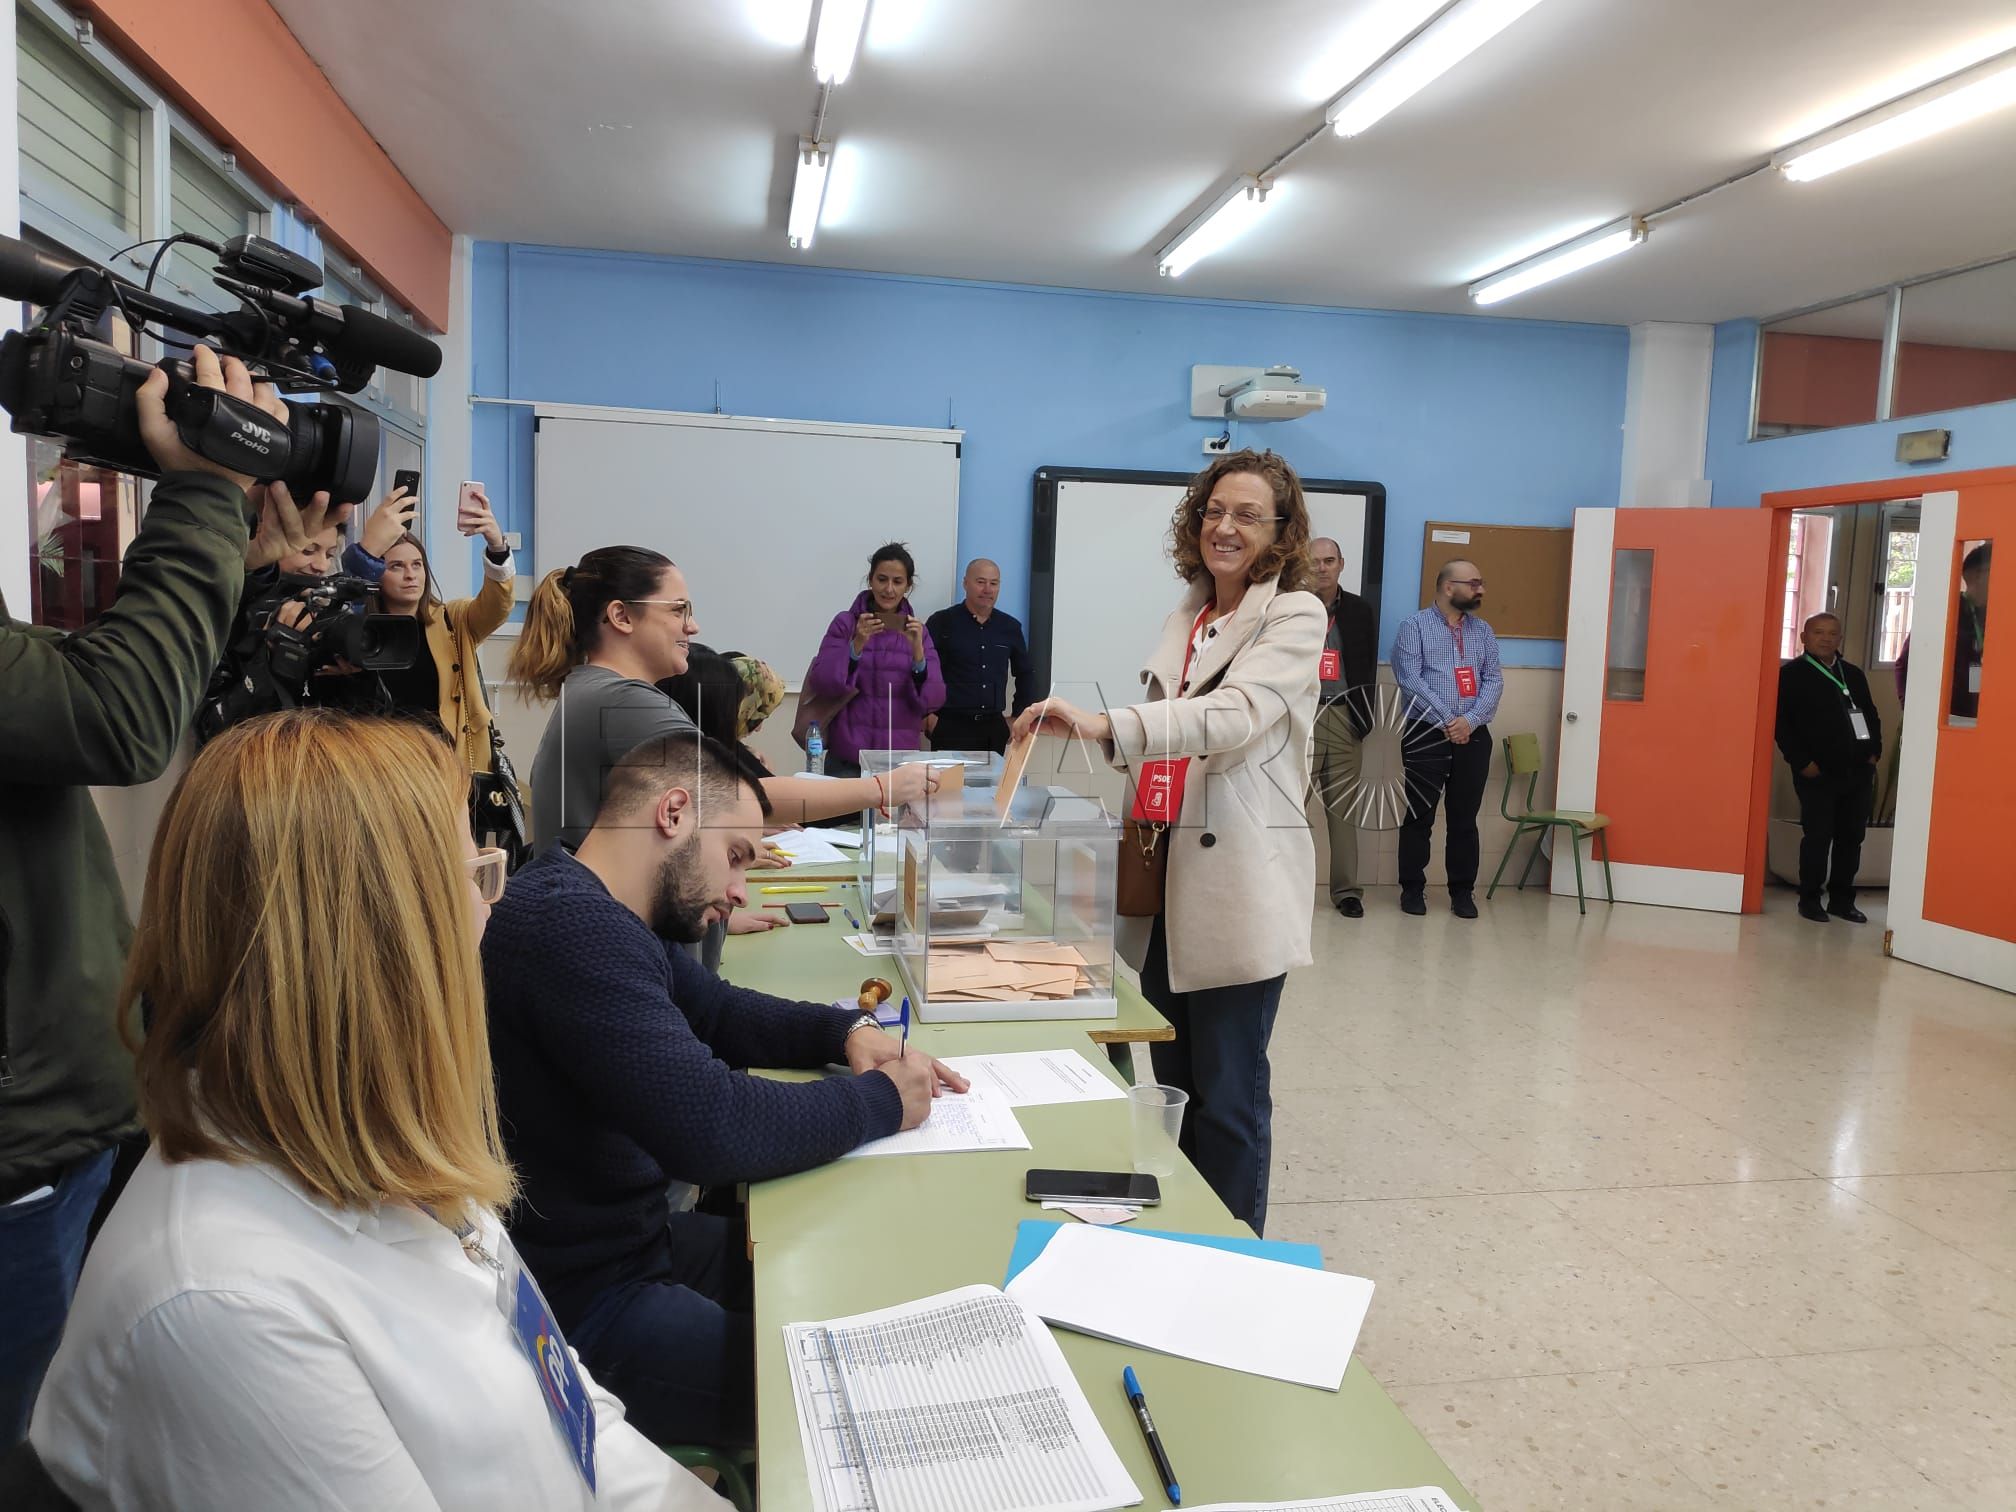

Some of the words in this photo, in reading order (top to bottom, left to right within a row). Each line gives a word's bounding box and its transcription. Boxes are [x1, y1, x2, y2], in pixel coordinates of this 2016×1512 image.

[231, 431, 270, 455] ProHD
[242, 421, 271, 443] JVC
[1152, 774, 1172, 783] PSOE
